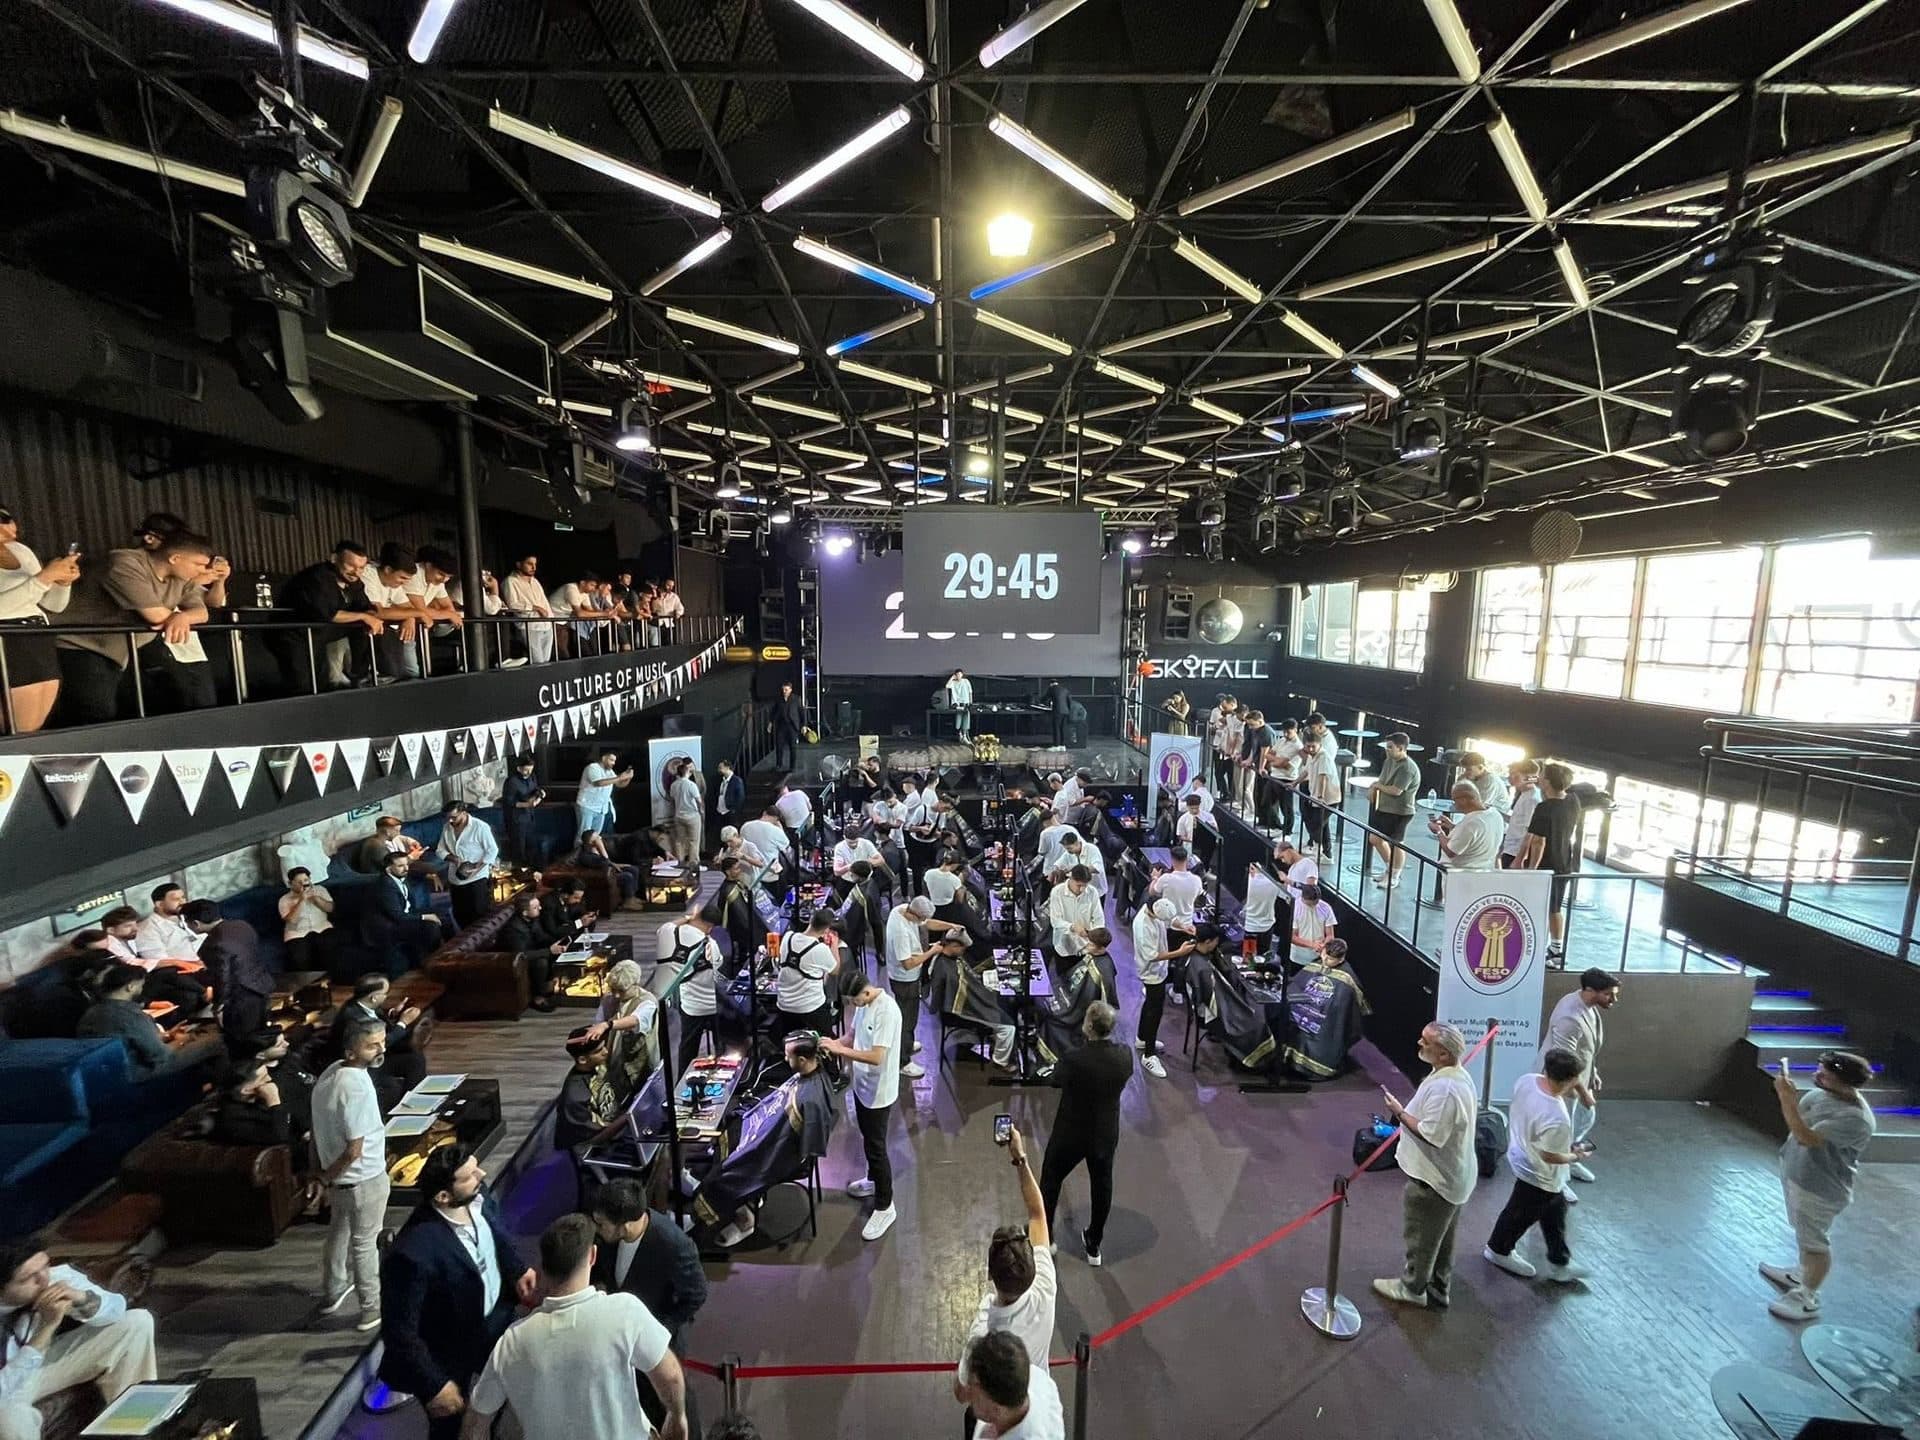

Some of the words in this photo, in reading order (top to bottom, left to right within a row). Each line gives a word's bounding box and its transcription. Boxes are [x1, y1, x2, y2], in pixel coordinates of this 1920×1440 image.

[943, 552, 1059, 600] 29:45
[1147, 654, 1269, 678] SKYFALL
[539, 672, 612, 708] CULTURE
[616, 667, 632, 689] OF
[635, 661, 668, 684] MUSIC
[175, 764, 205, 778] Shay
[1474, 967, 1510, 976] FESO
